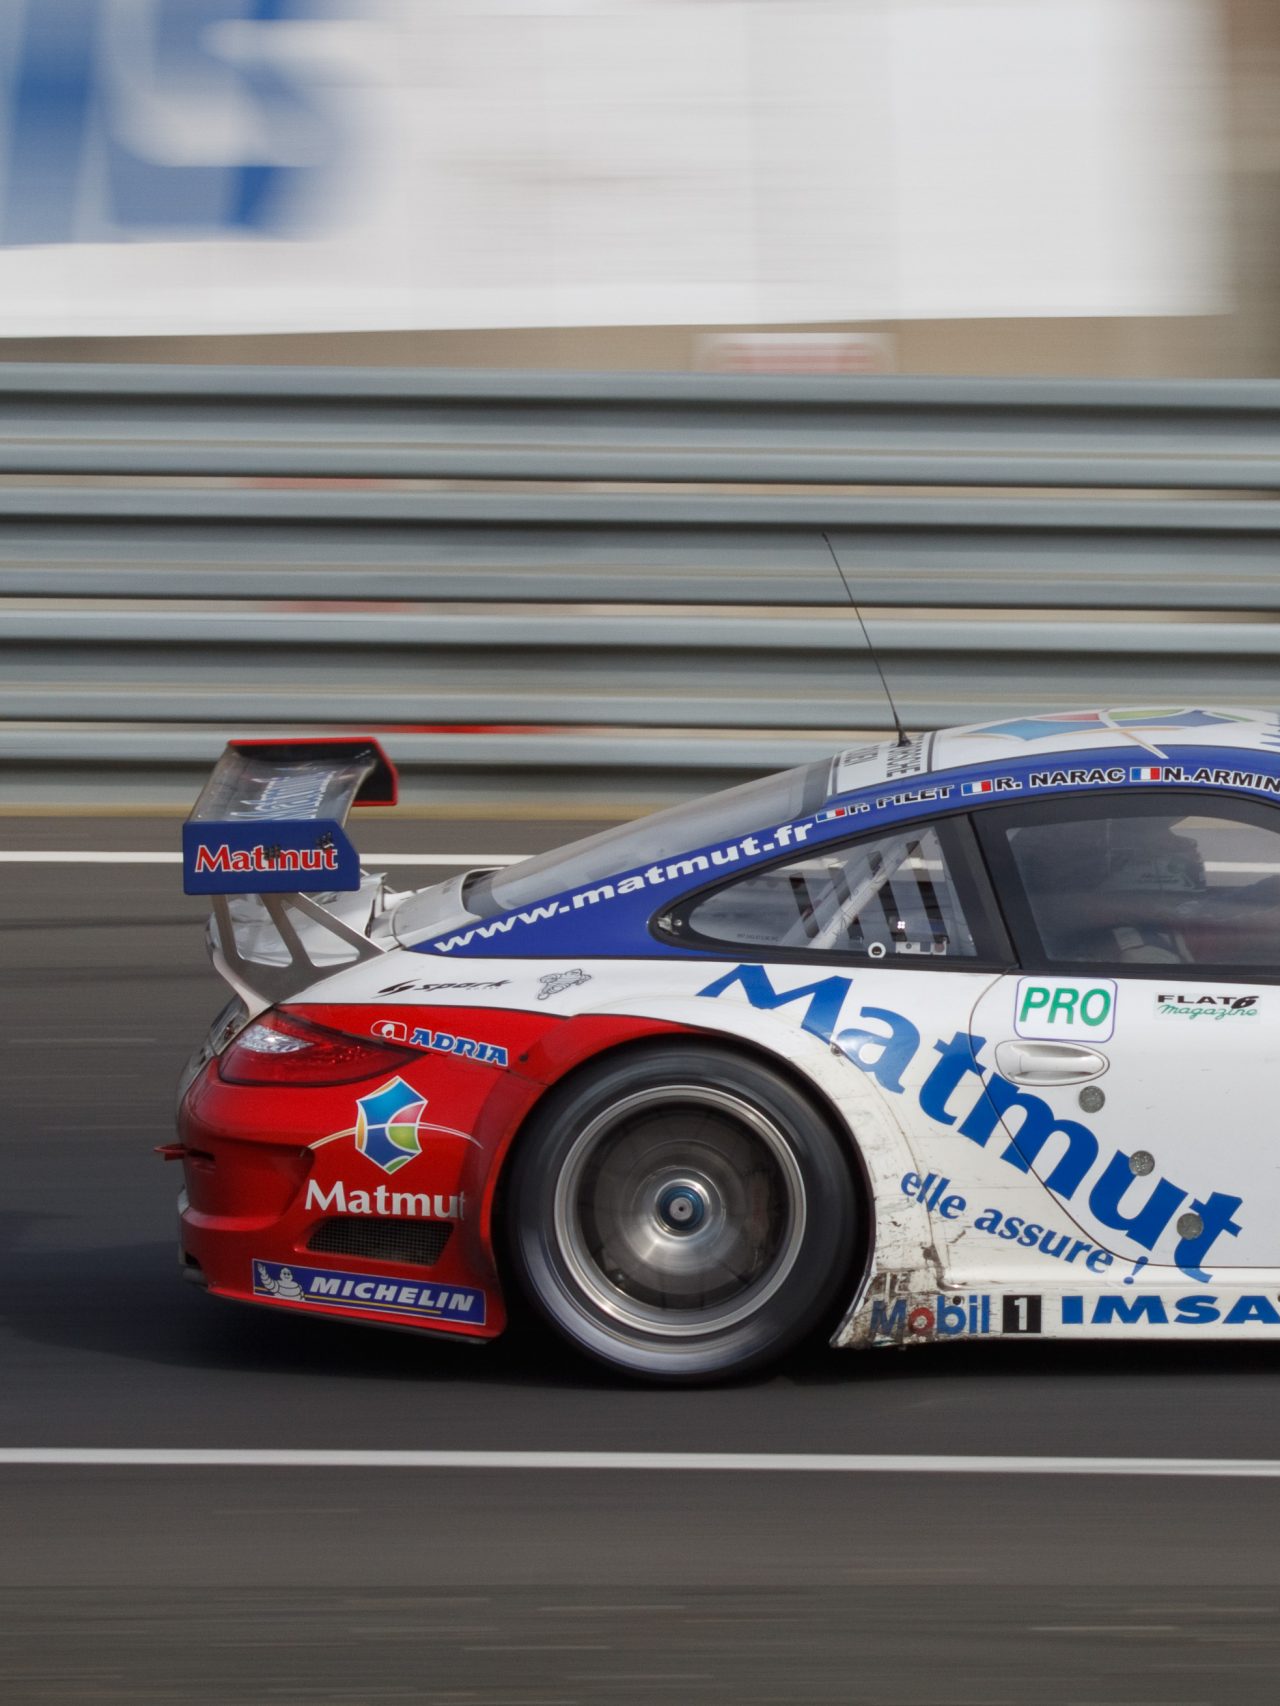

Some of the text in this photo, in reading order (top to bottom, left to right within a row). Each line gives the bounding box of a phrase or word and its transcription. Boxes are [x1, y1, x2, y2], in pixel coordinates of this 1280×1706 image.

[995, 777, 1023, 792] R.
[1030, 767, 1126, 788] NARAC
[194, 844, 338, 873] Matmut
[434, 821, 814, 953] www.matmut.fr
[1019, 987, 1112, 1027] PRO
[1157, 1003, 1258, 1020] magazine
[409, 1027, 509, 1067] ADRIA
[696, 964, 1243, 1284] Matmut
[901, 1170, 967, 1220] elle
[974, 1208, 1114, 1273] assure
[310, 1276, 474, 1312] MICHELIN
[869, 1294, 990, 1336] Mobil
